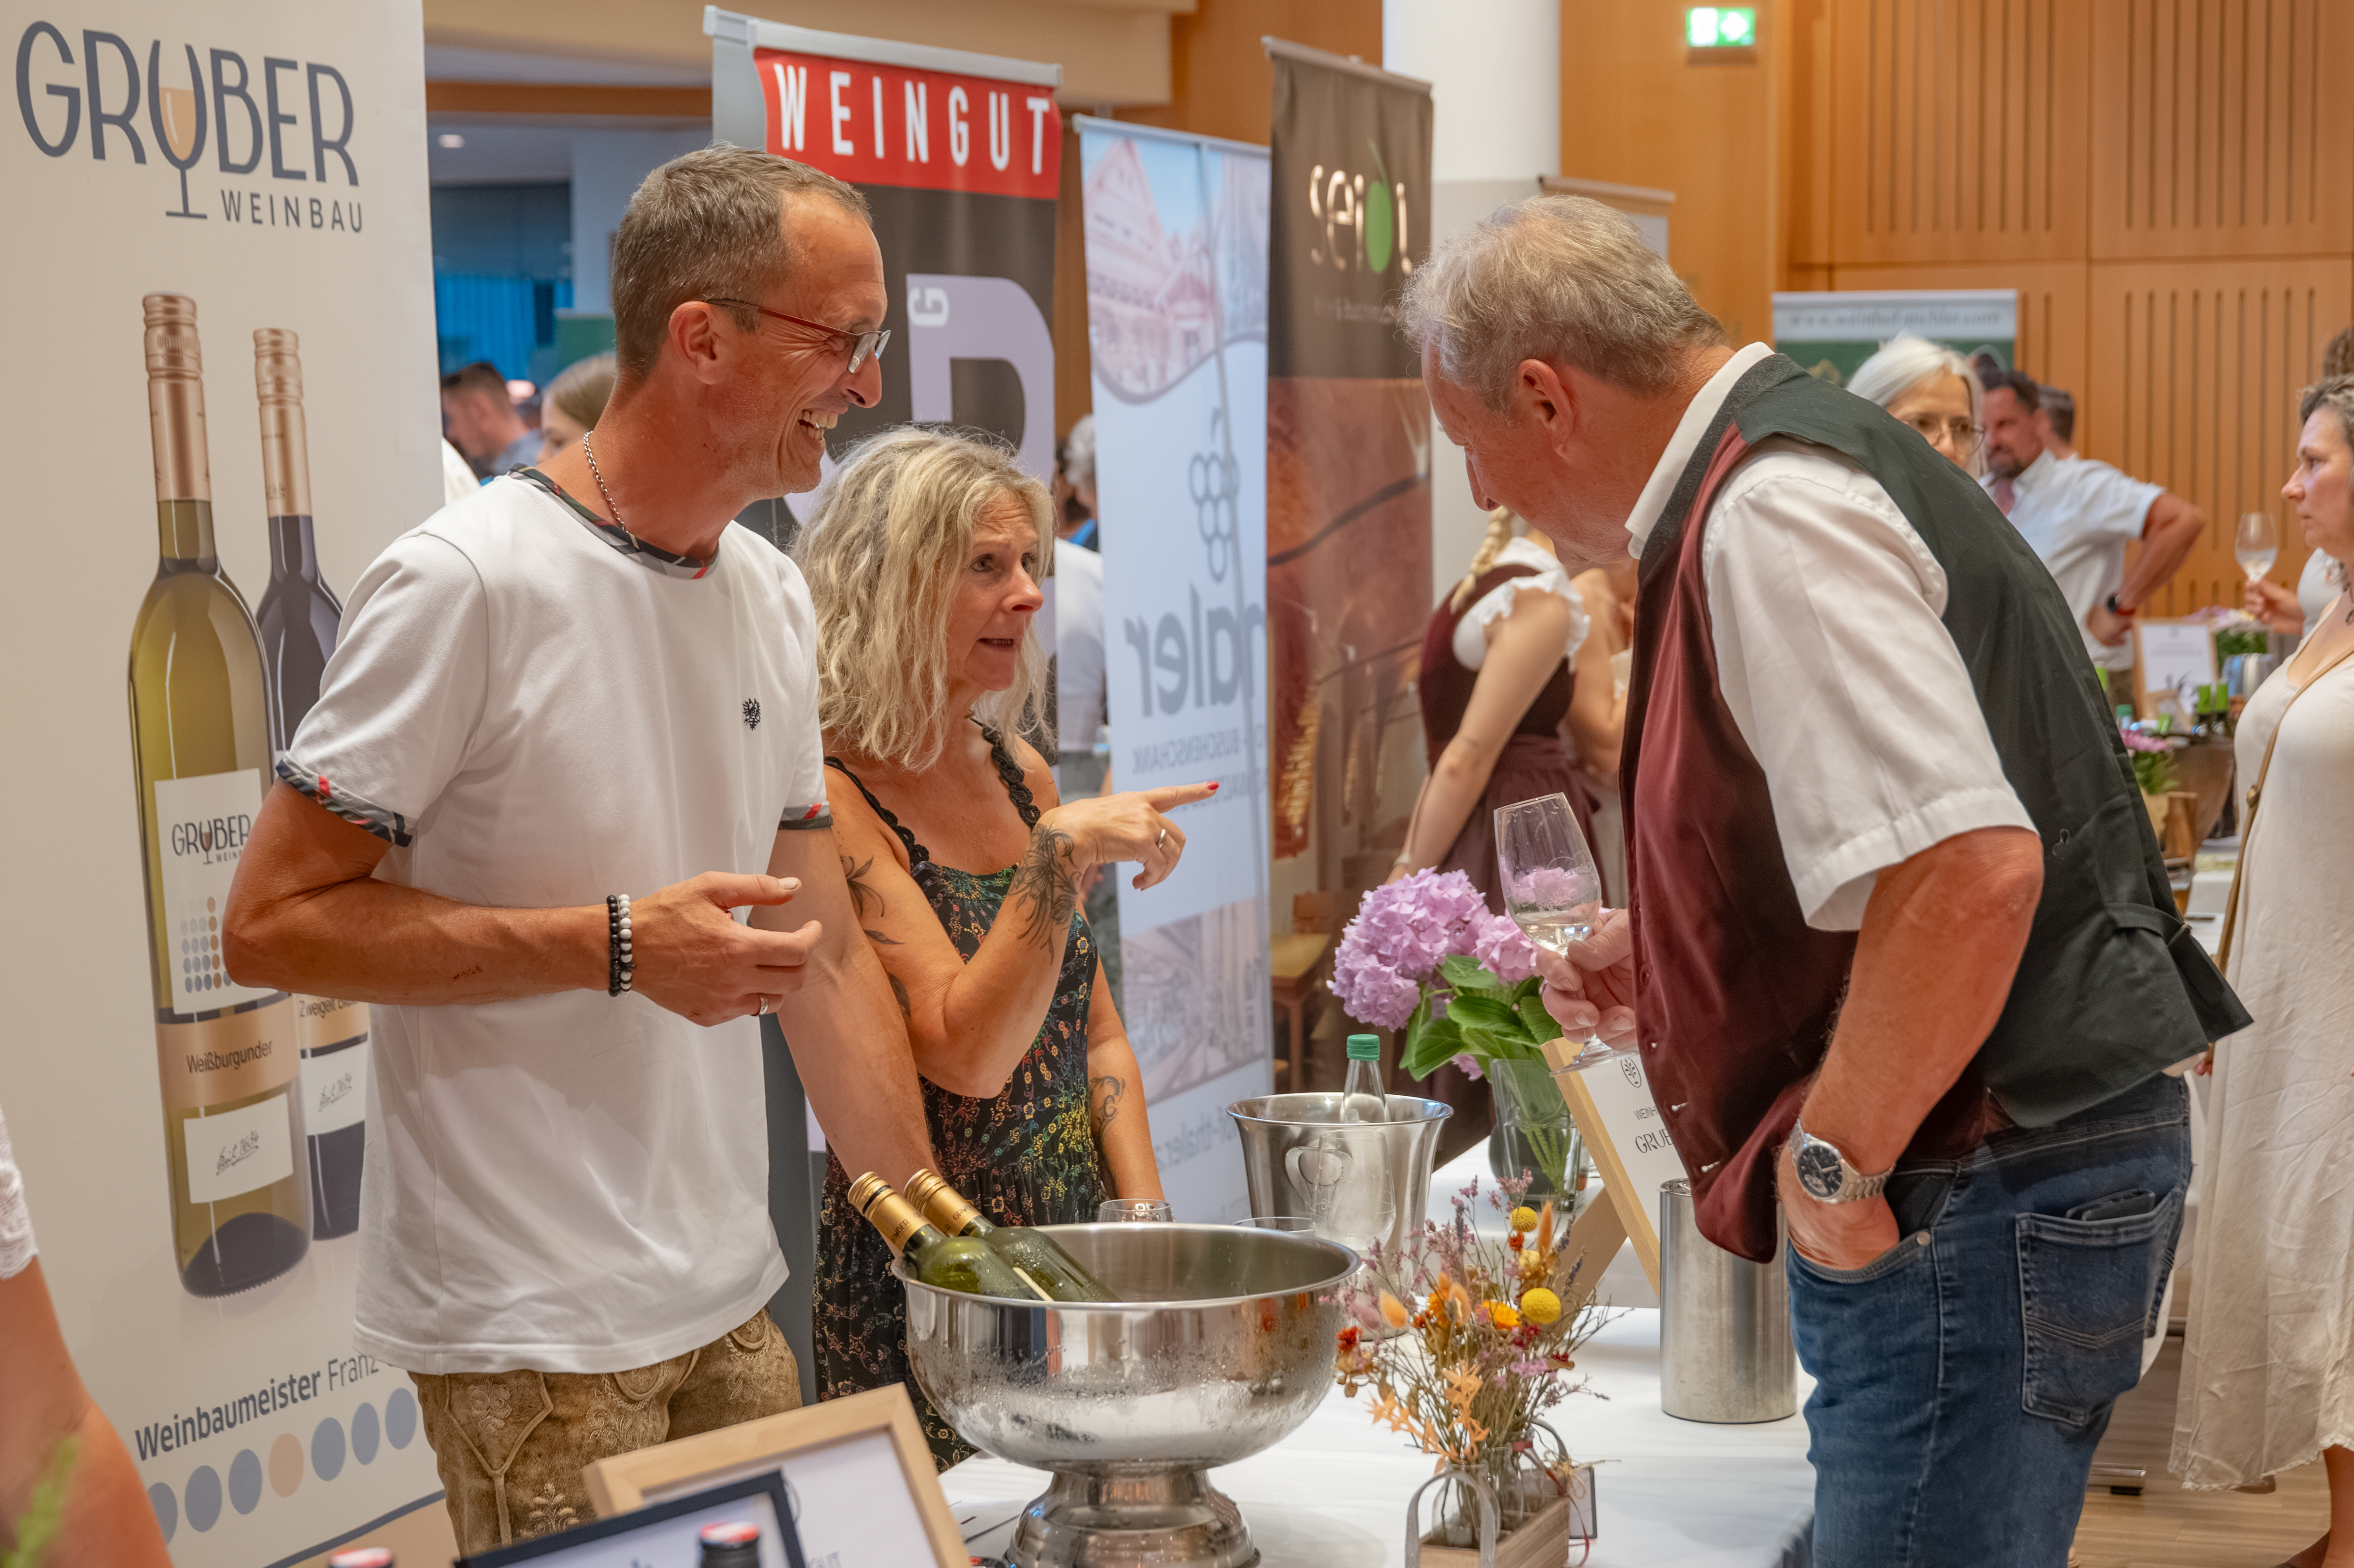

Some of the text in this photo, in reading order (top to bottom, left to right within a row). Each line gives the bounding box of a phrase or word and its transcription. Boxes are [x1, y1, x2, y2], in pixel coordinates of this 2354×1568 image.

[16, 21, 359, 188] GRUBER
[774, 63, 1049, 174] WEINGUT
[220, 189, 362, 233] WEINBAU
[172, 814, 251, 856] GRUBER
[186, 1040, 273, 1074] Weißburgunder
[1634, 1105, 1658, 1121] WEINH
[134, 1355, 379, 1462] Weinbaumeister Franz
